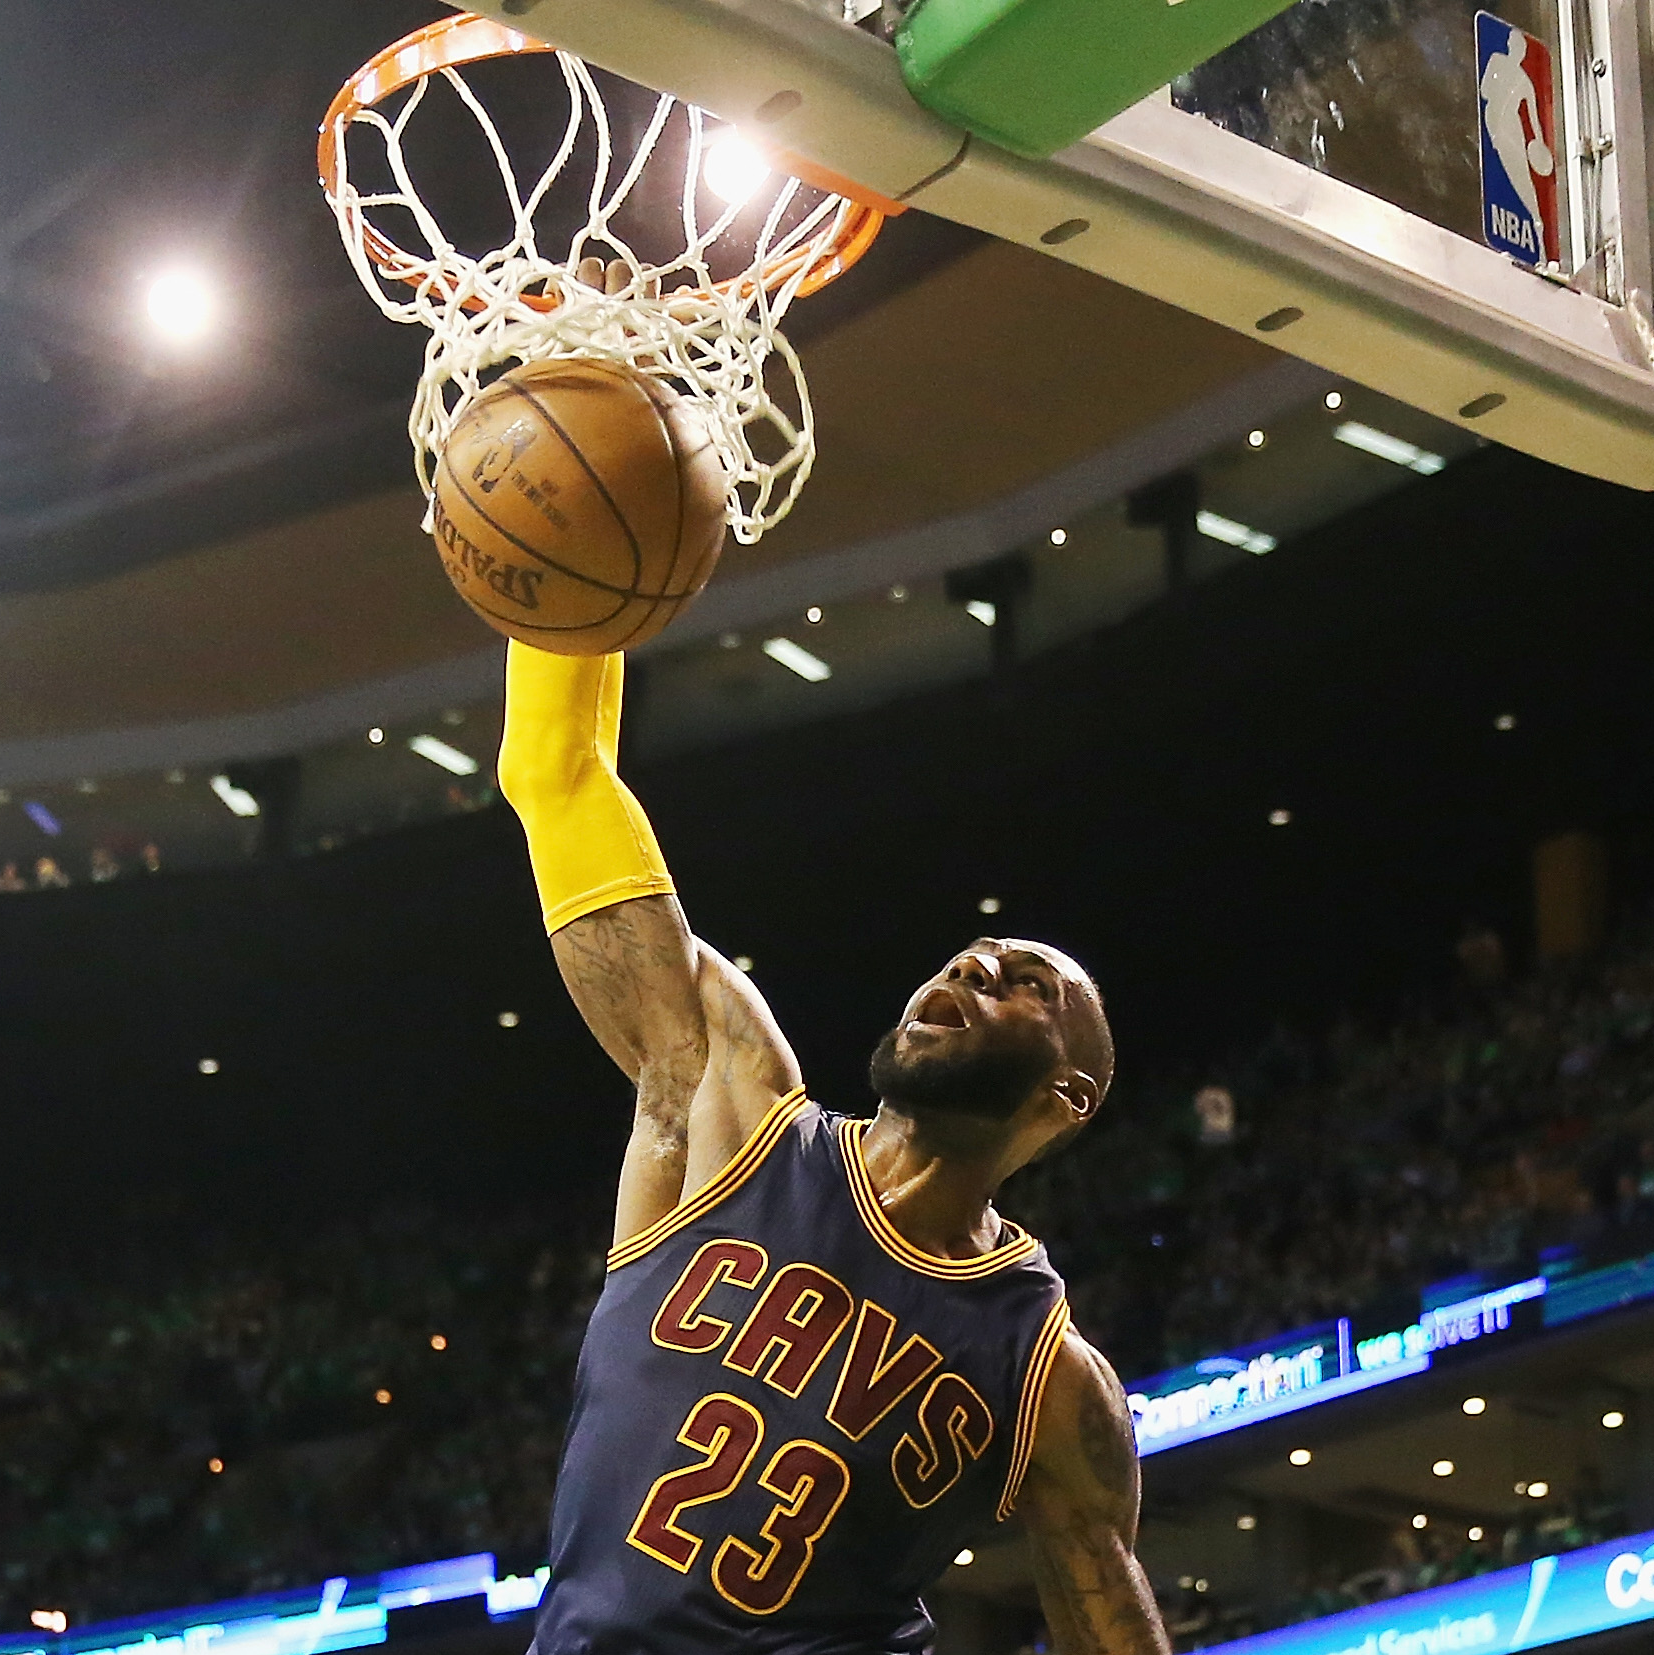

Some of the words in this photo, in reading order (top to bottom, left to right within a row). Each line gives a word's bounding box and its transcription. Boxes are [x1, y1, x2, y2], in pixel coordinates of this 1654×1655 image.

[1491, 203, 1536, 254] NBA
[651, 1238, 995, 1509] CAVS
[625, 1392, 851, 1615] 23
